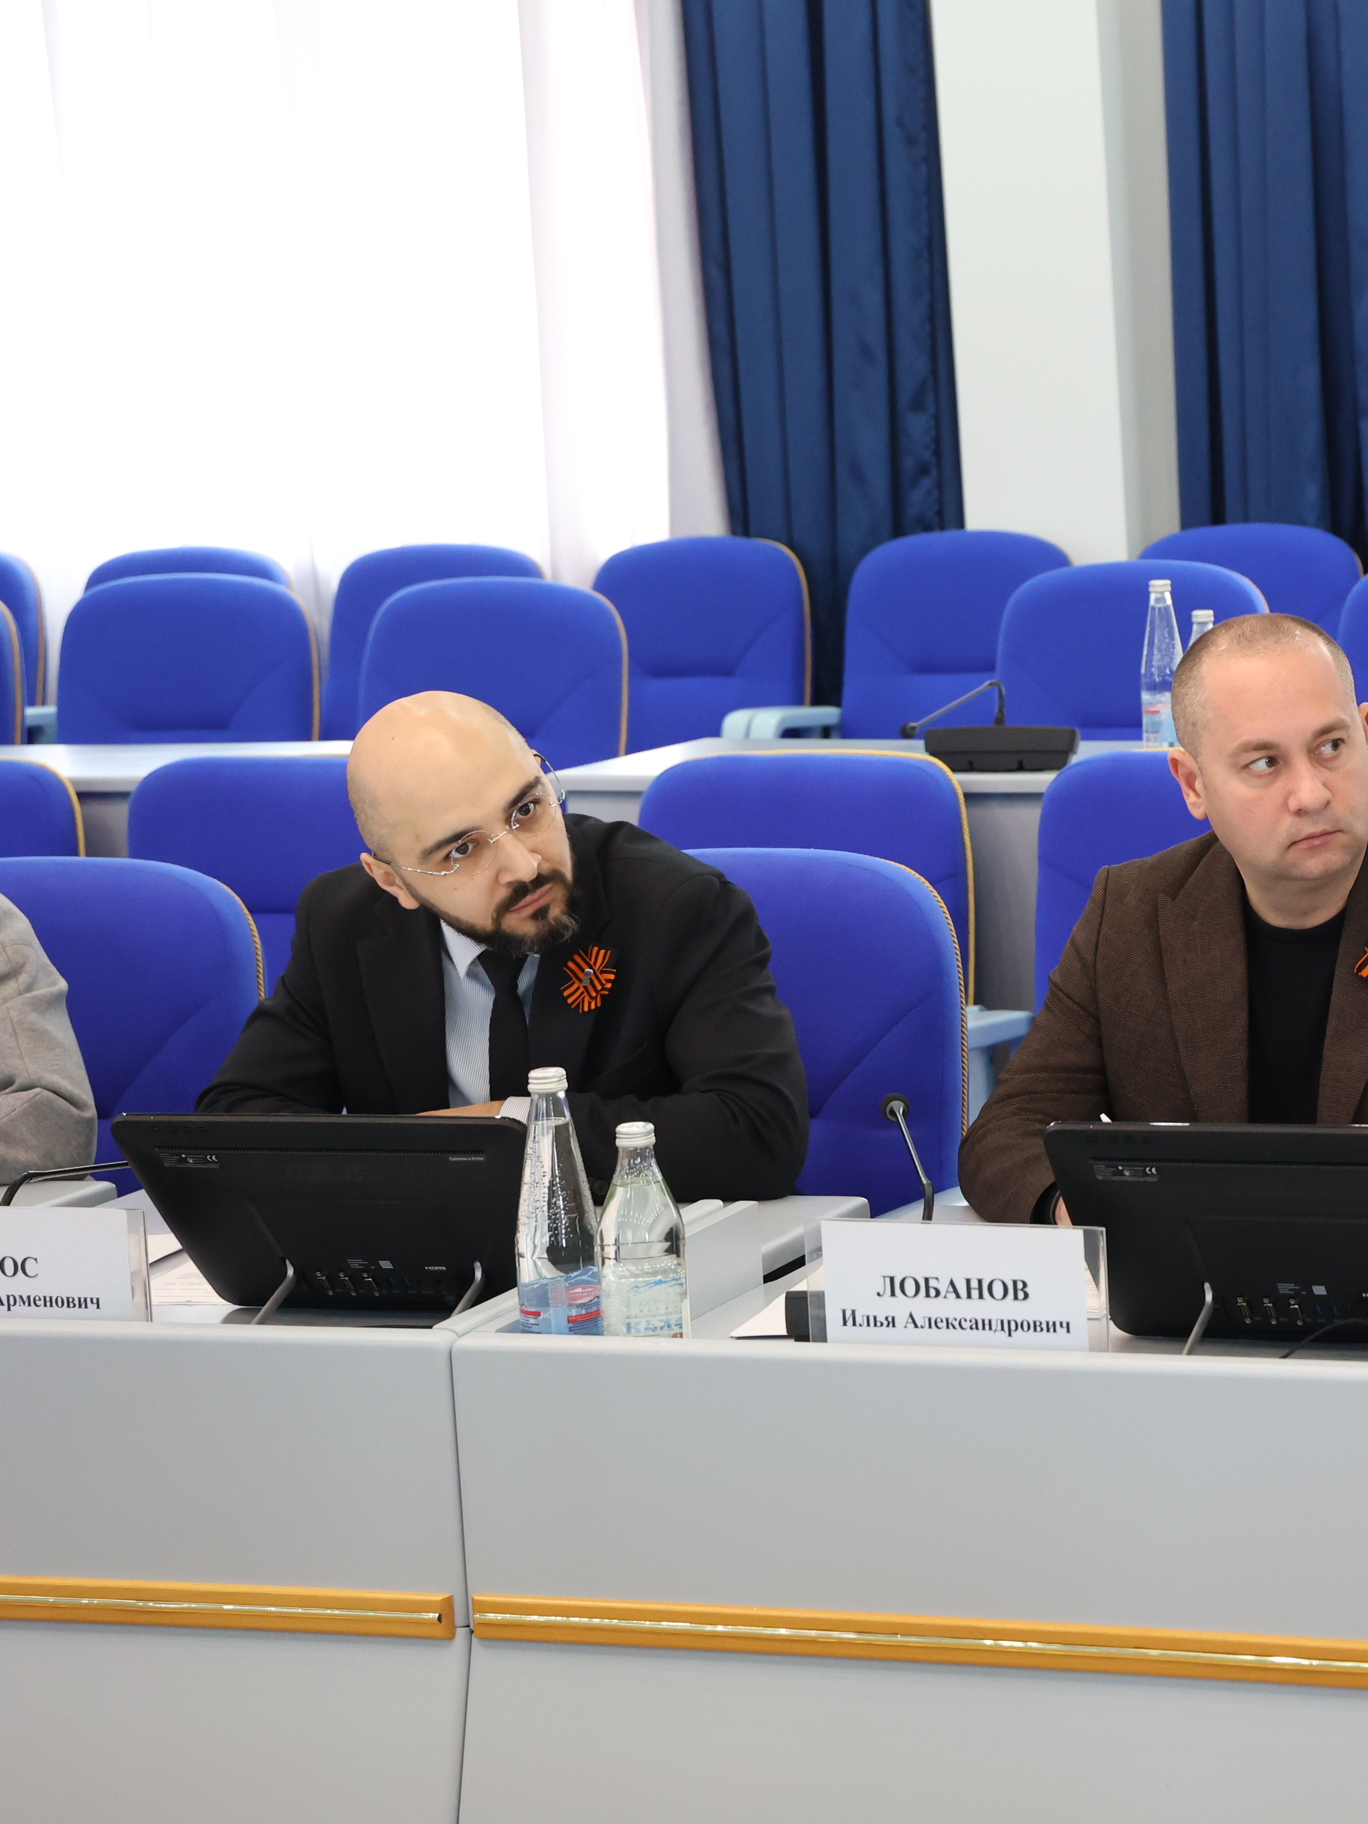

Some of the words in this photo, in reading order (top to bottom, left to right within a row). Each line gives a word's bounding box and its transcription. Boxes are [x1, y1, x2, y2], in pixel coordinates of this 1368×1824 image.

[876, 1274, 1031, 1302] ЛОБАНОВ
[840, 1308, 897, 1329] Илья
[903, 1311, 1072, 1338] Александрович
